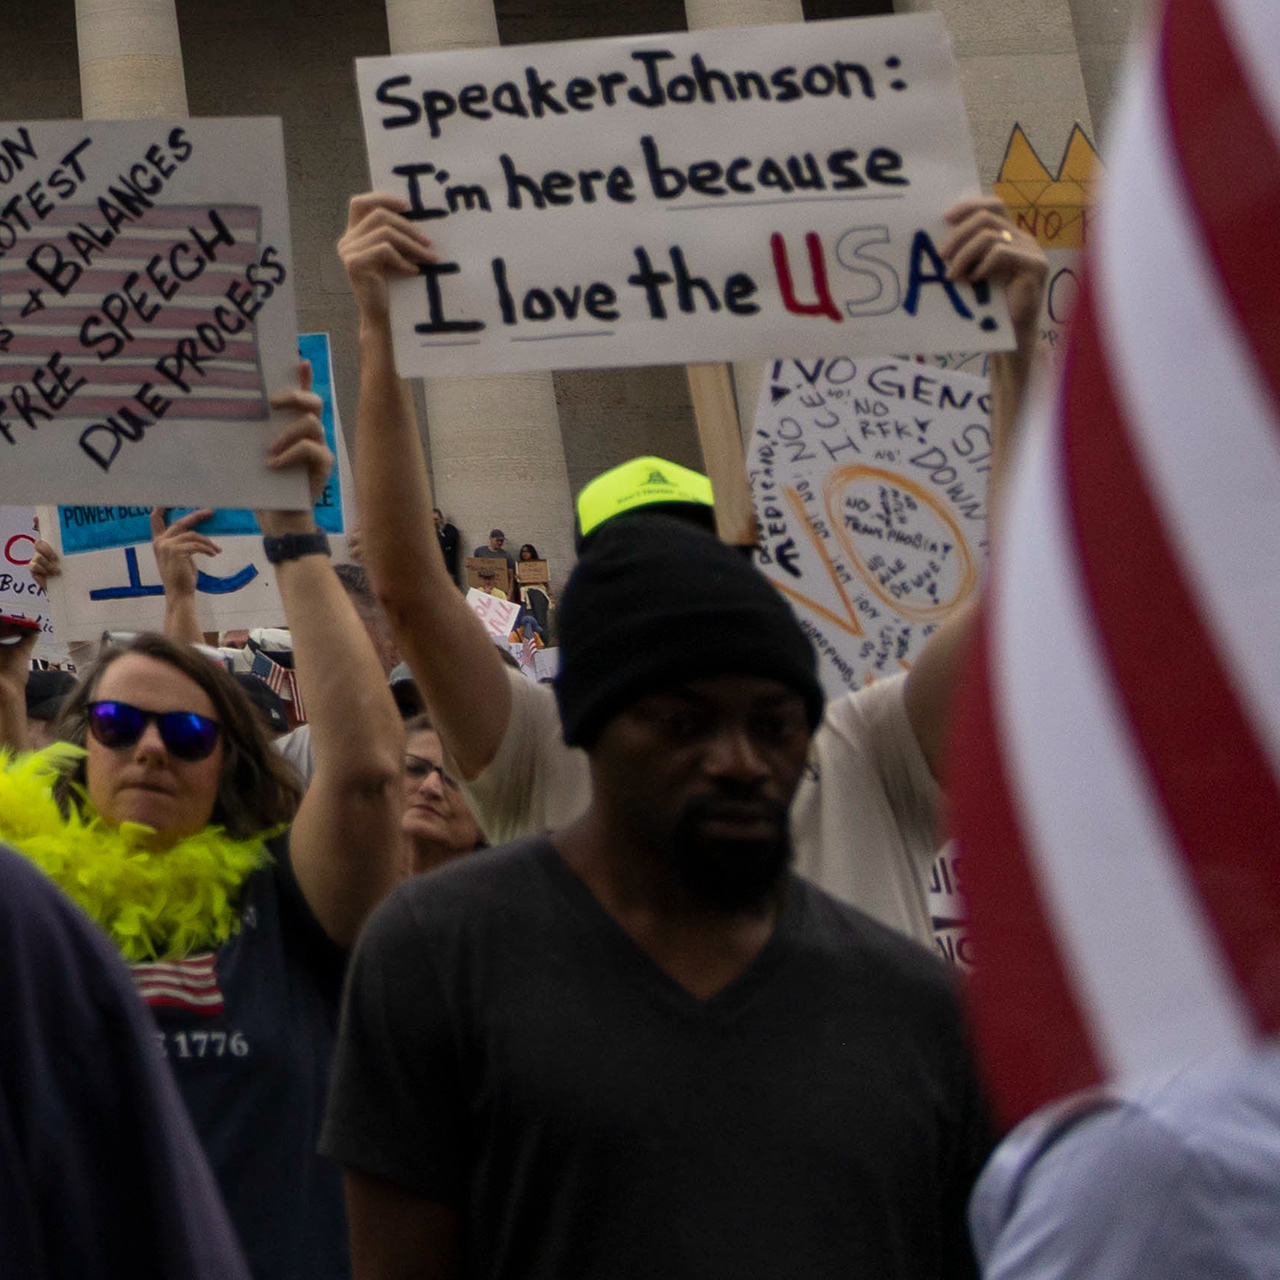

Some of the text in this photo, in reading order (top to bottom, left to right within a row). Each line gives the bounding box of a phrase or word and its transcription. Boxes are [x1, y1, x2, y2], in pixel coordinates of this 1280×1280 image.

[26, 126, 193, 298] BALANCES
[392, 135, 911, 221] I'm here because
[78, 209, 236, 362] SPEECH
[414, 262, 487, 334] I
[492, 257, 621, 325] love
[628, 245, 761, 320] the
[770, 225, 999, 332] USA!
[78, 381, 173, 472] DUE
[155, 245, 287, 394] PROCESS
[854, 397, 889, 417] NO
[63, 505, 115, 529] POWER
[173, 1030, 250, 1059] 1776
